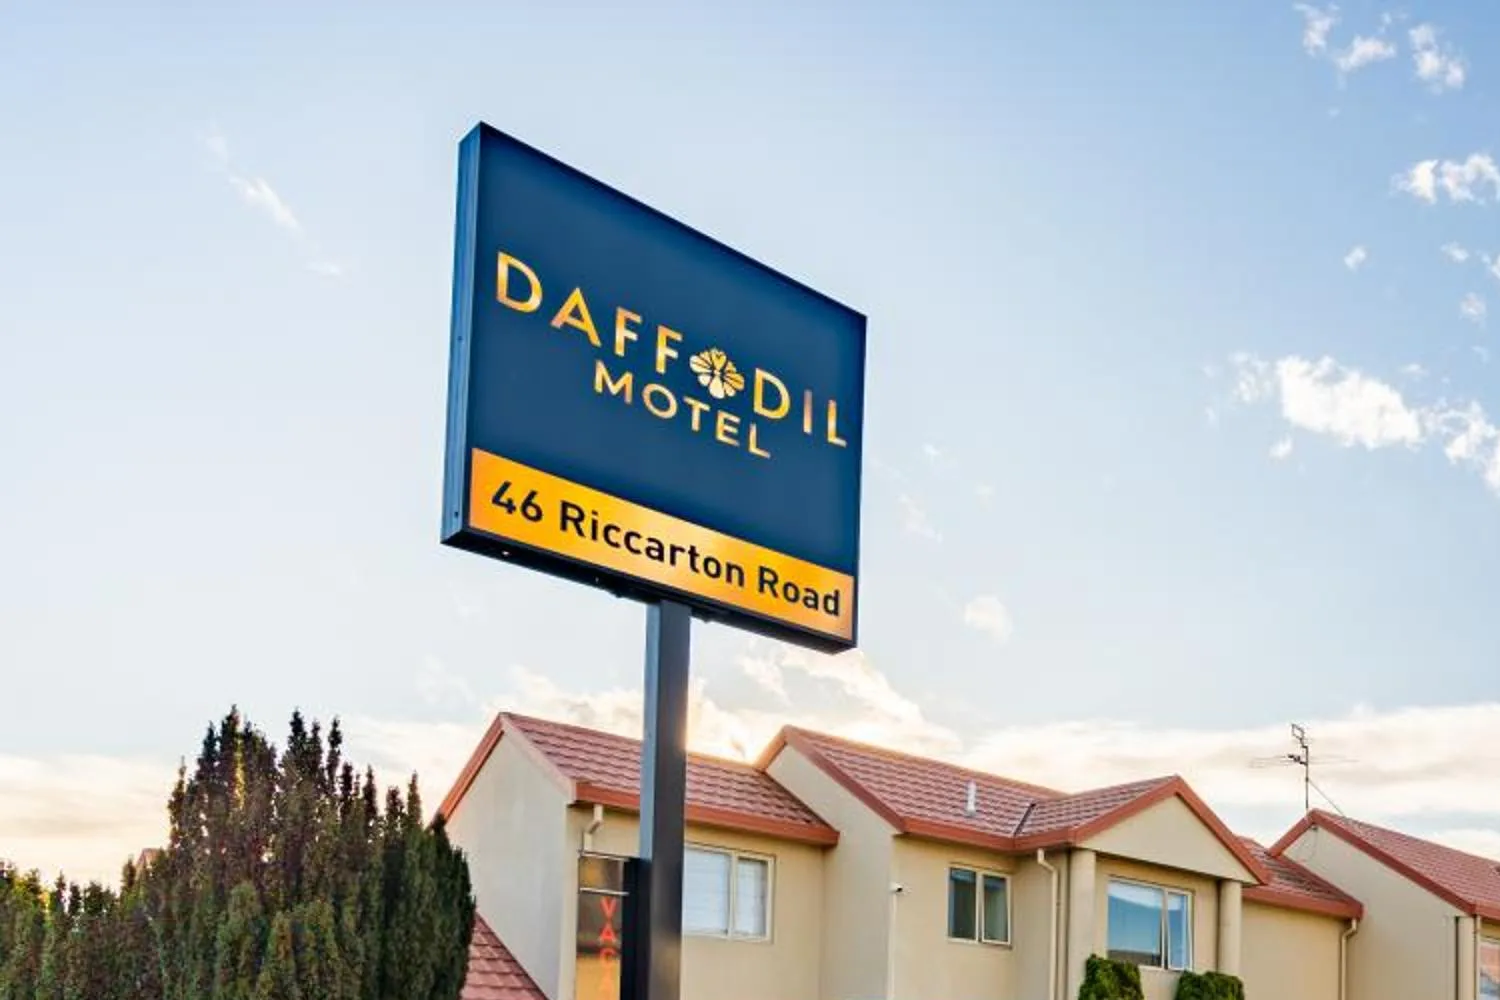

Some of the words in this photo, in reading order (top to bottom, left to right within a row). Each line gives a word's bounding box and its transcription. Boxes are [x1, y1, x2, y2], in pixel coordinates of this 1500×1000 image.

[595, 361, 771, 459] MOTEL
[491, 480, 543, 524] 46
[559, 500, 746, 588] Riccarton
[757, 565, 840, 617] Road
